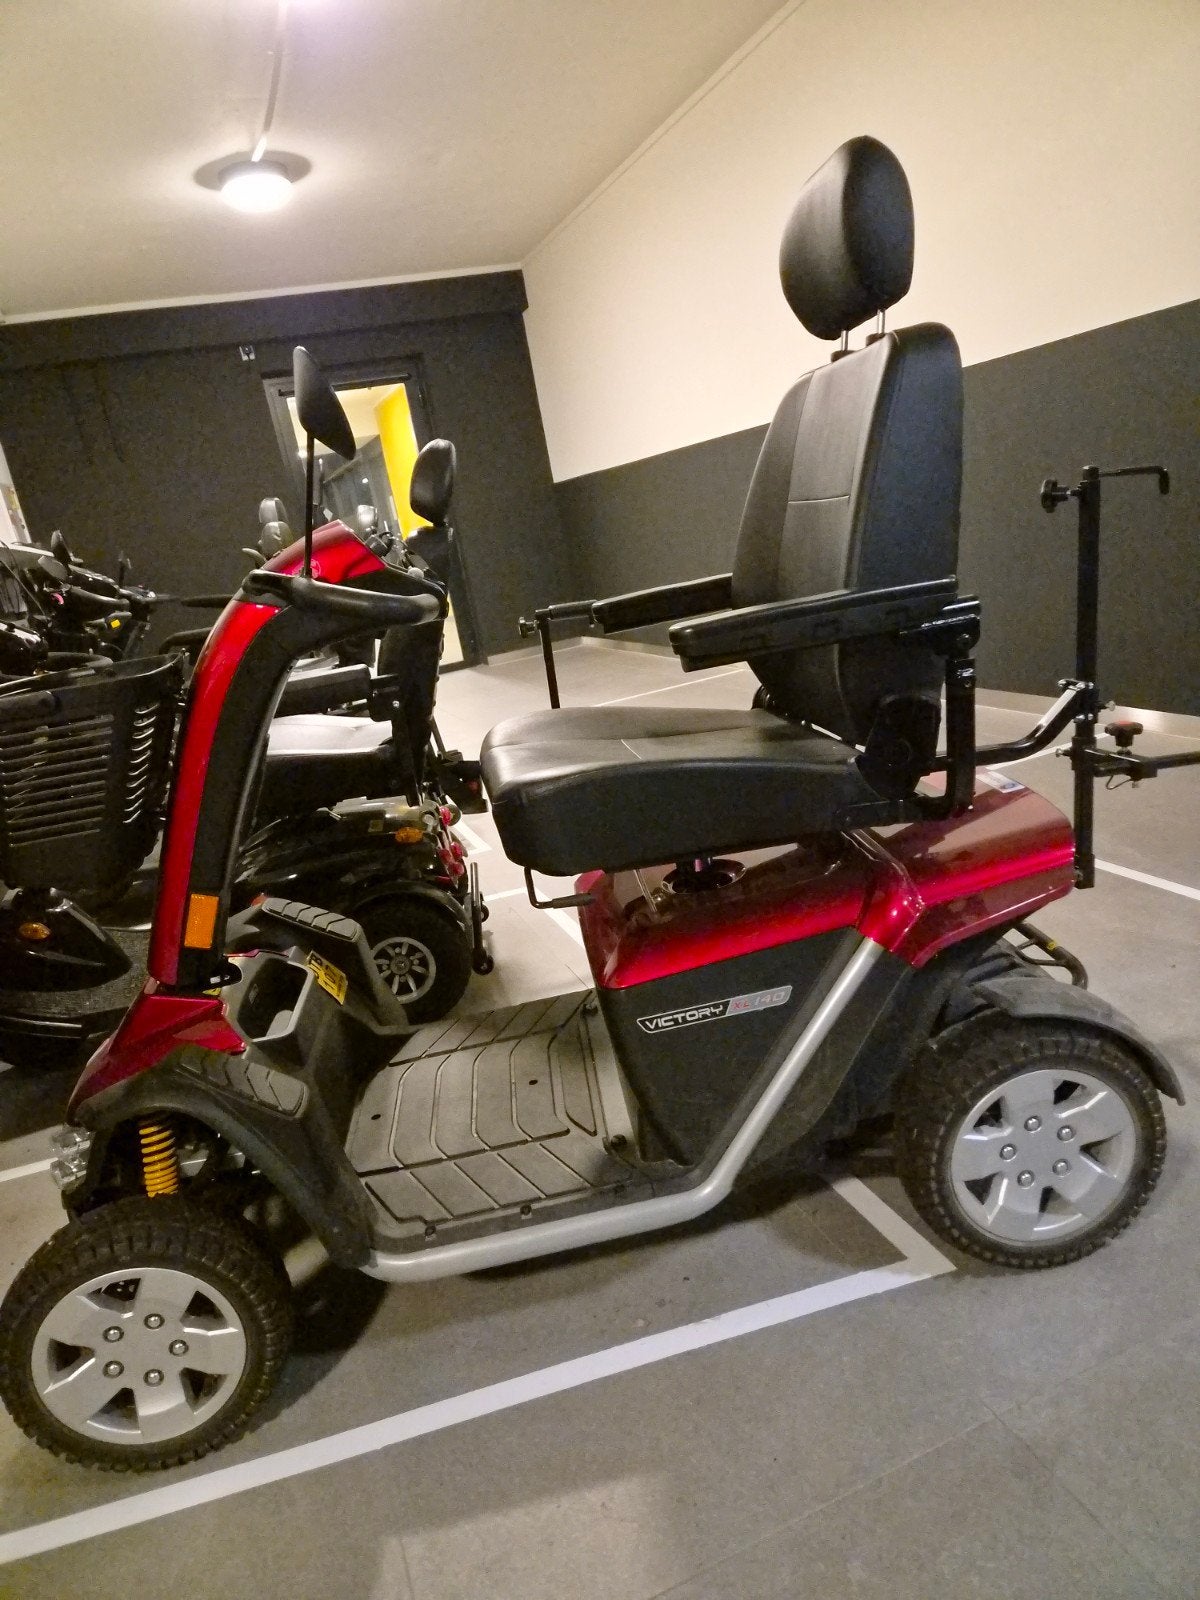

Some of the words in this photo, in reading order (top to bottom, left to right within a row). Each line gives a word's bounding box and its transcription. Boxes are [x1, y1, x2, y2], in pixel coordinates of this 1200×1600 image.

[645, 1004, 723, 1030] VICTORY
[732, 1000, 750, 1010] XL
[754, 991, 786, 1006] 140
